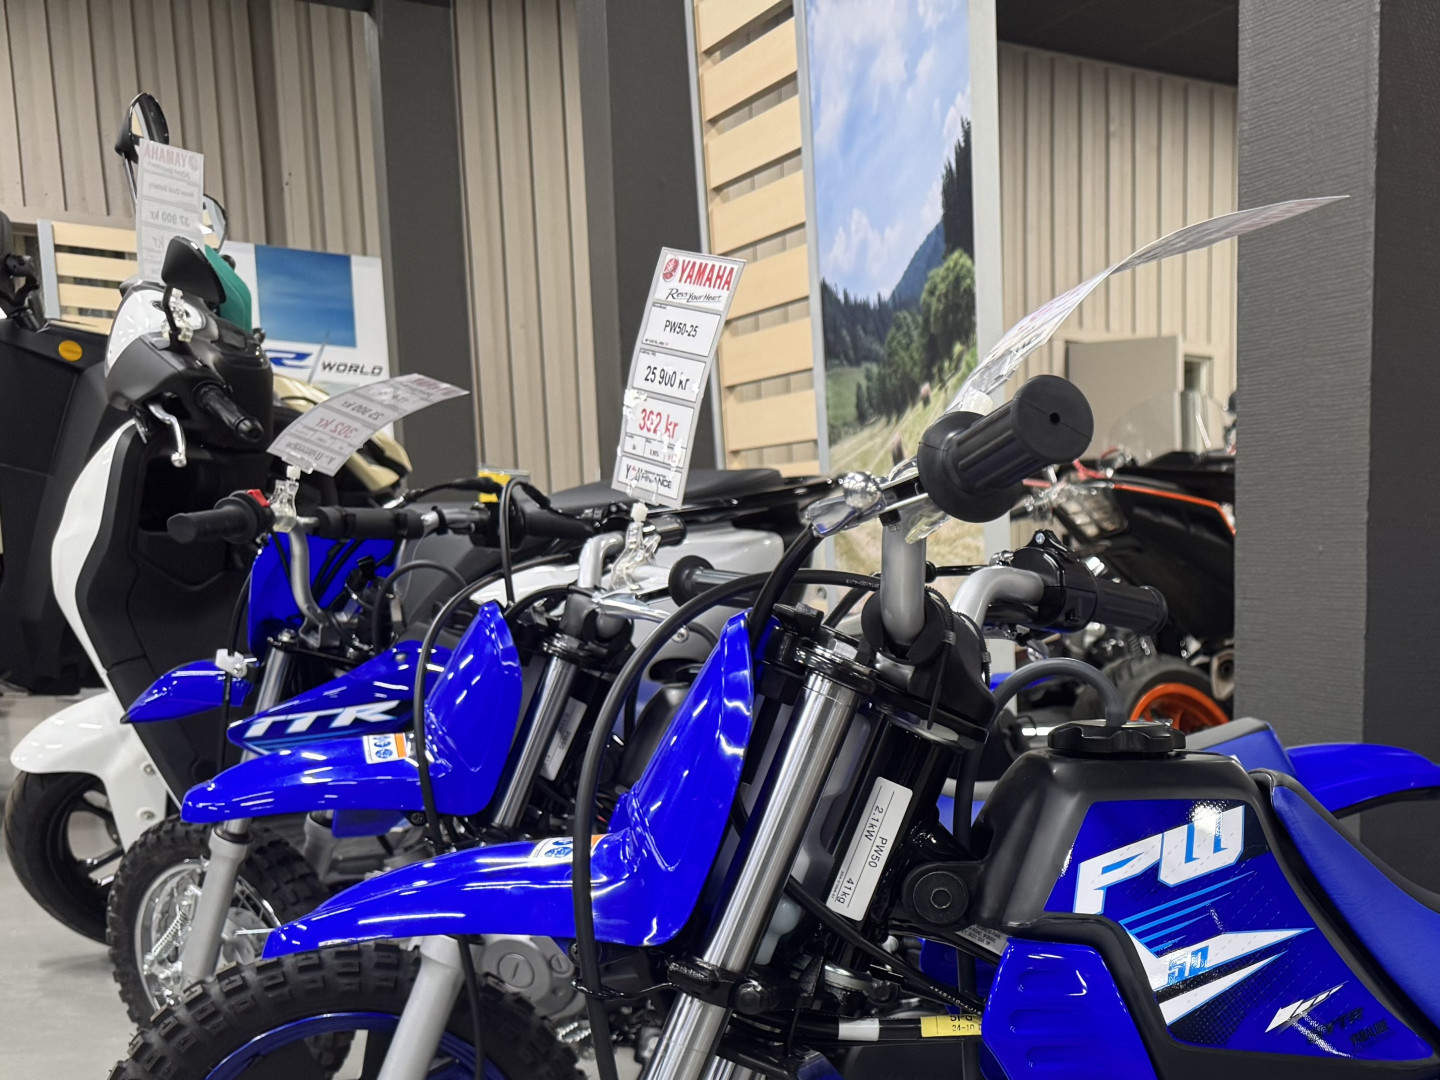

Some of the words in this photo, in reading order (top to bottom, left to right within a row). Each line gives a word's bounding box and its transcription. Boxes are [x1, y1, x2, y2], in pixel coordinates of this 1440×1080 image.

[678, 259, 735, 291] YAMAHA
[665, 287, 688, 300] Revs
[686, 291, 703, 302] Your
[703, 293, 722, 302] Heart
[663, 319, 699, 338] PW50-25
[321, 360, 384, 377] WORLD
[644, 365, 656, 383] 25
[243, 699, 401, 739] TTR
[864, 804, 884, 842] 2.1kW
[868, 835, 888, 868] PW50
[1072, 804, 1245, 915] PW
[837, 877, 855, 904] 41kg
